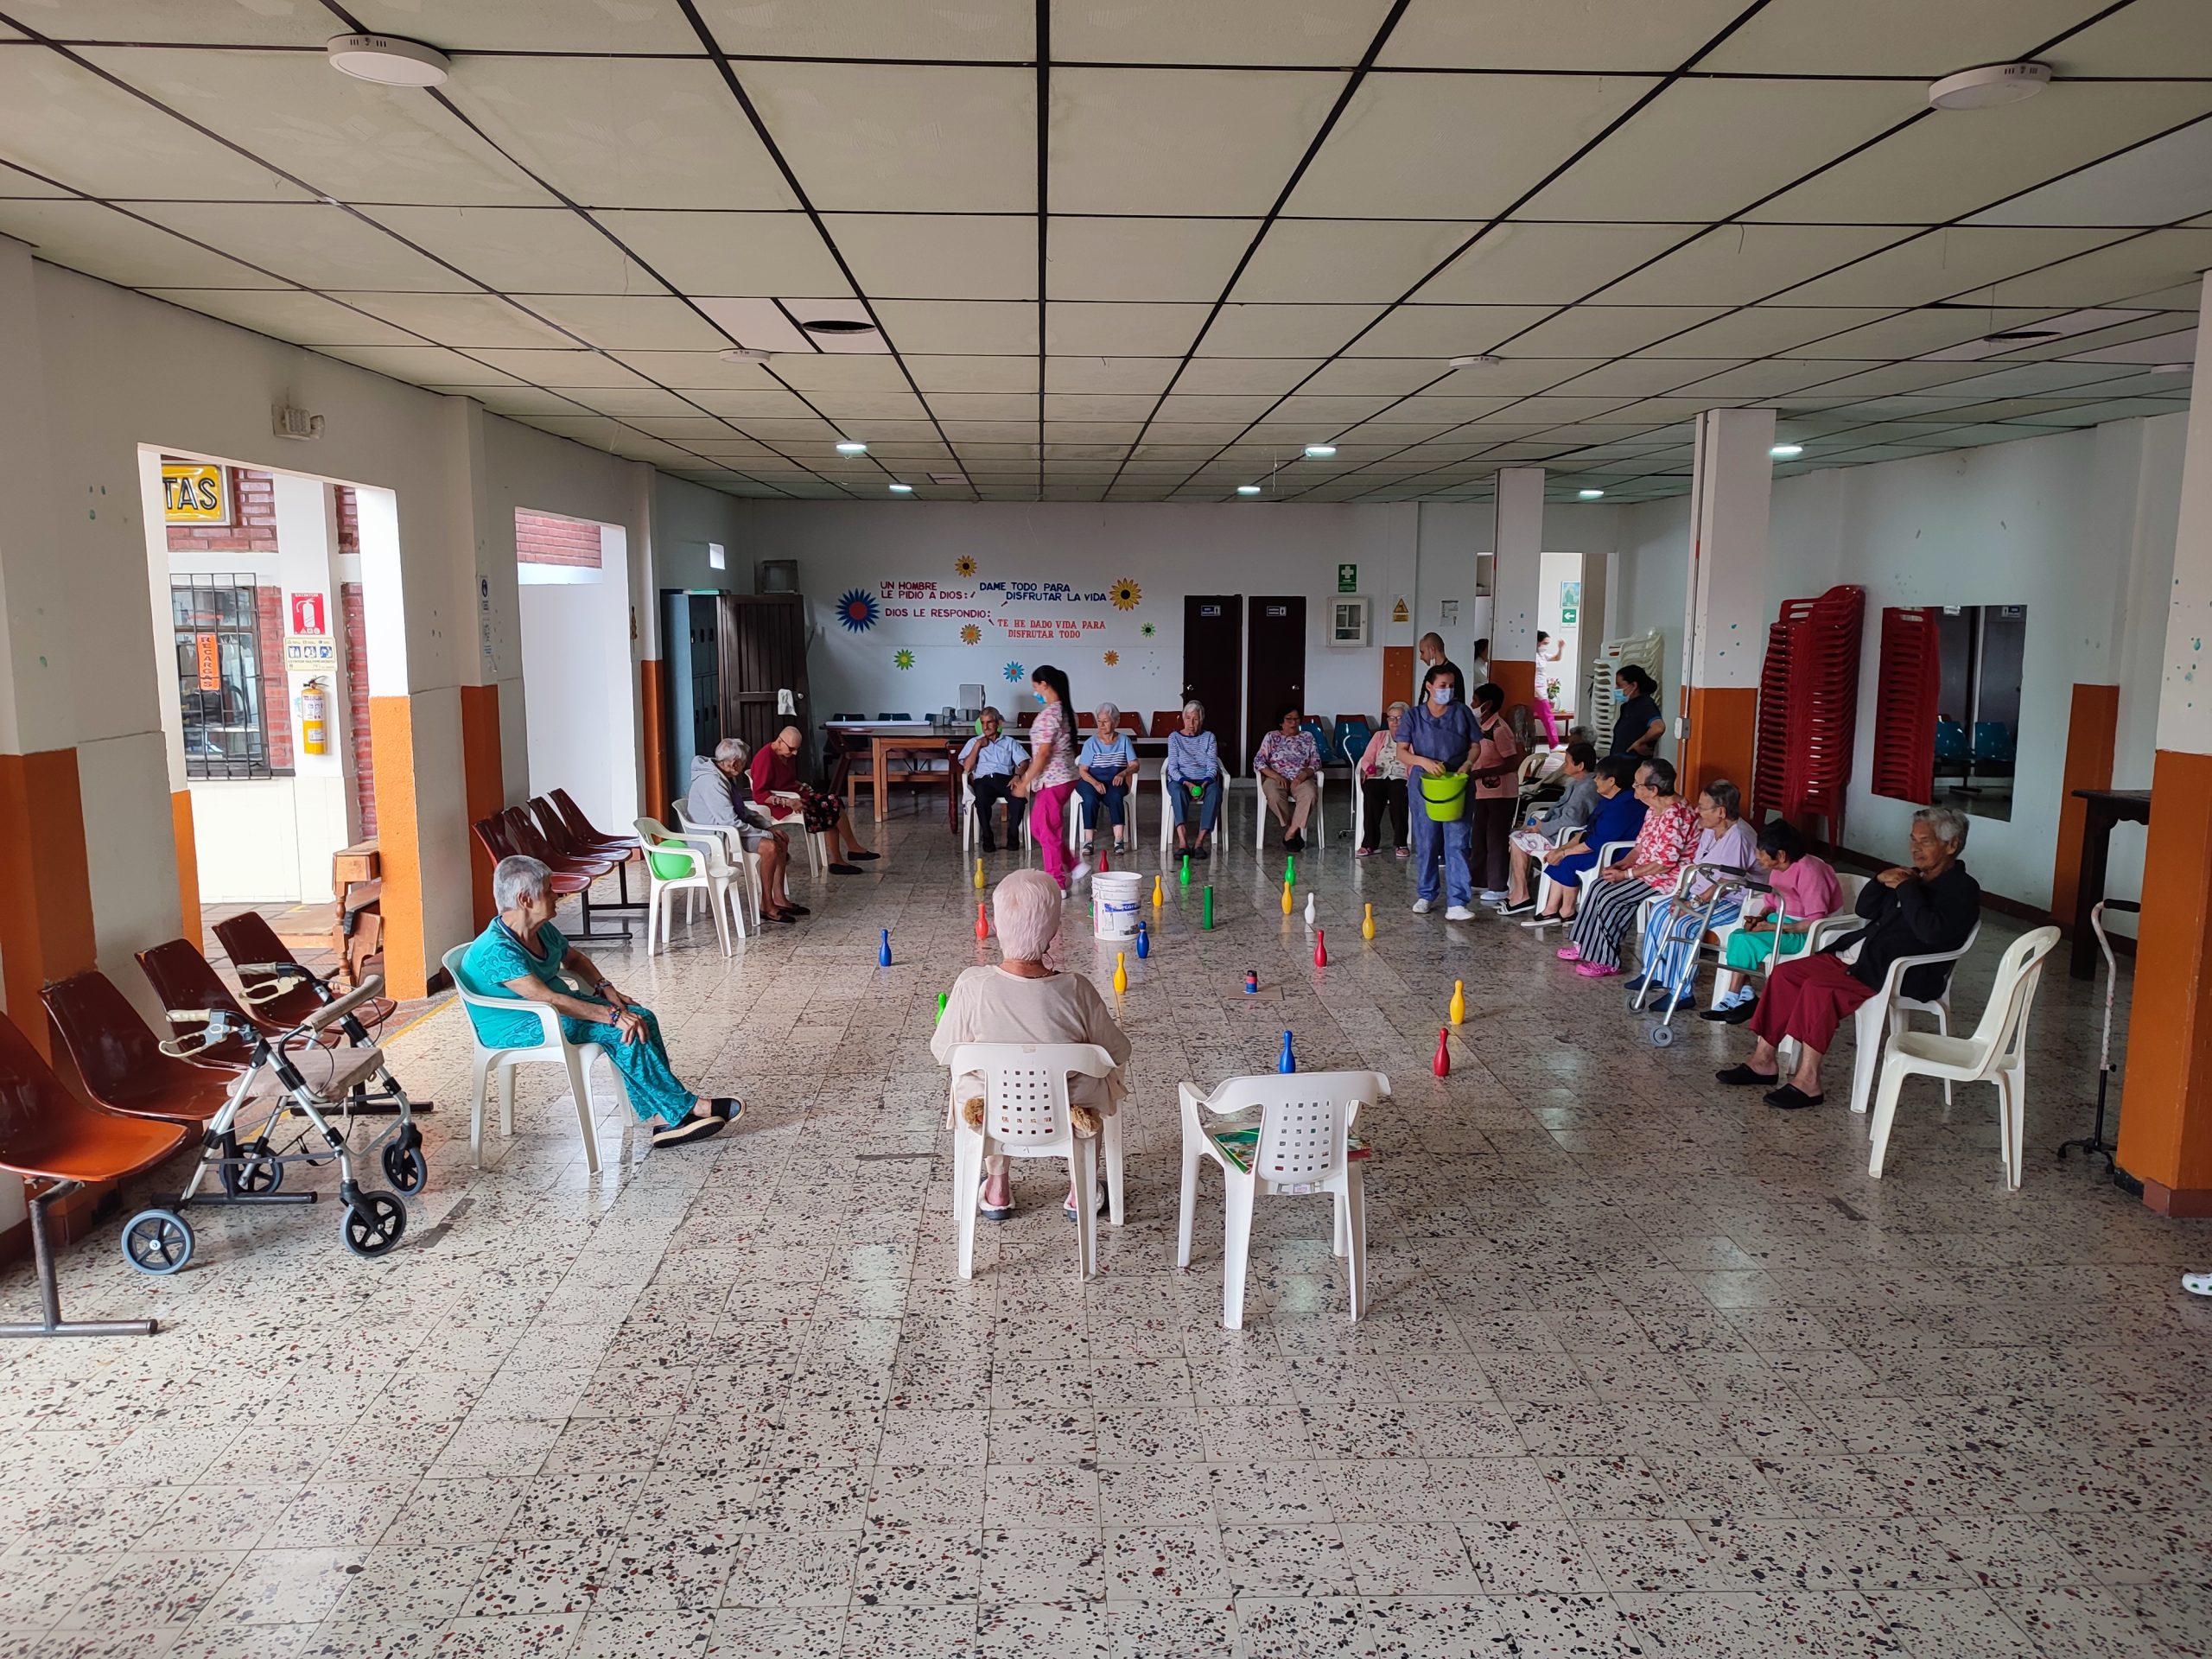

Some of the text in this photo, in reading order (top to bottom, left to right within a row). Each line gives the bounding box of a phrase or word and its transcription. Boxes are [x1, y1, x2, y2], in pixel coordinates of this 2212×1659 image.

[162, 477, 217, 511] TAS
[880, 581, 938, 591] UN HOMBRE
[979, 582, 1071, 593] DAME TODO PARA
[880, 590, 968, 600] LE PIDIO A DIOS:
[1006, 591, 1107, 601] DISFRUTAR LA VIDA
[885, 607, 991, 619] DIOS LE RESPONDIO:
[997, 619, 1106, 629] TE HE DADO VIDA PARA
[1007, 629, 1081, 639] DISFRUTAR TODO
[200, 636, 213, 688] RECARGAS
